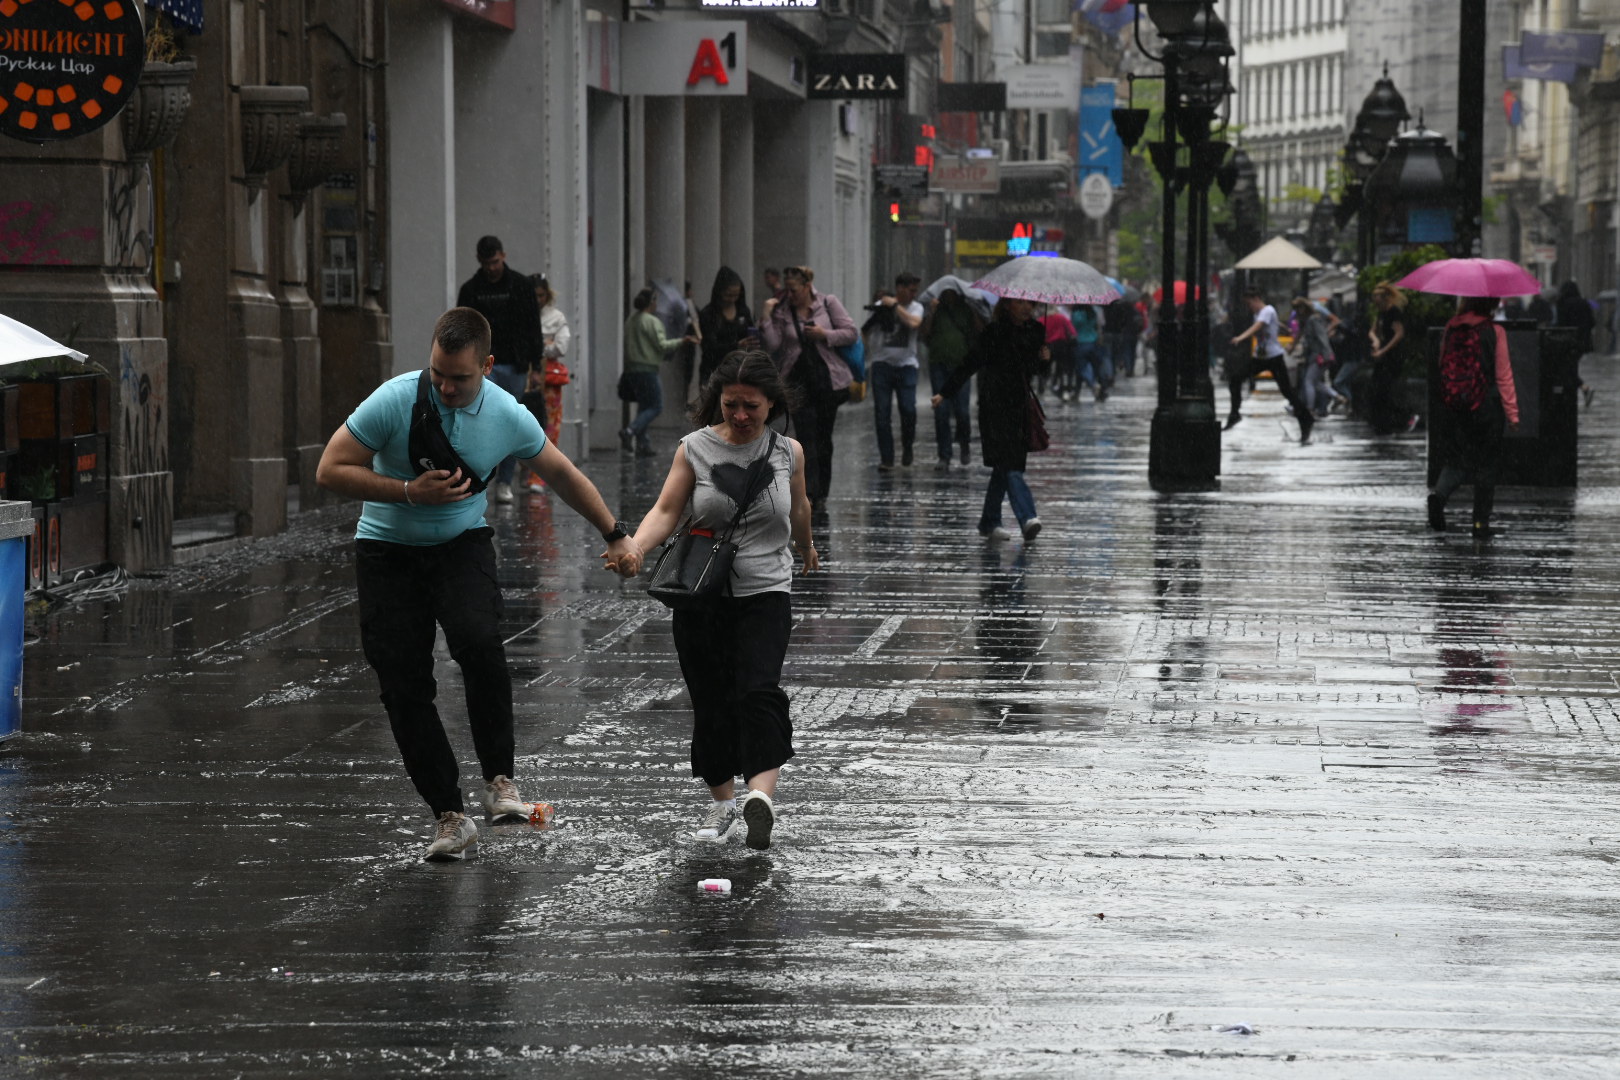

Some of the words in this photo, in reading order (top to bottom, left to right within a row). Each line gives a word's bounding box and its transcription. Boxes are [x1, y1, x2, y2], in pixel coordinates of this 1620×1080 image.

[61, 58, 95, 75] Цар
[686, 32, 736, 85] A1
[814, 74, 899, 91] ZARA
